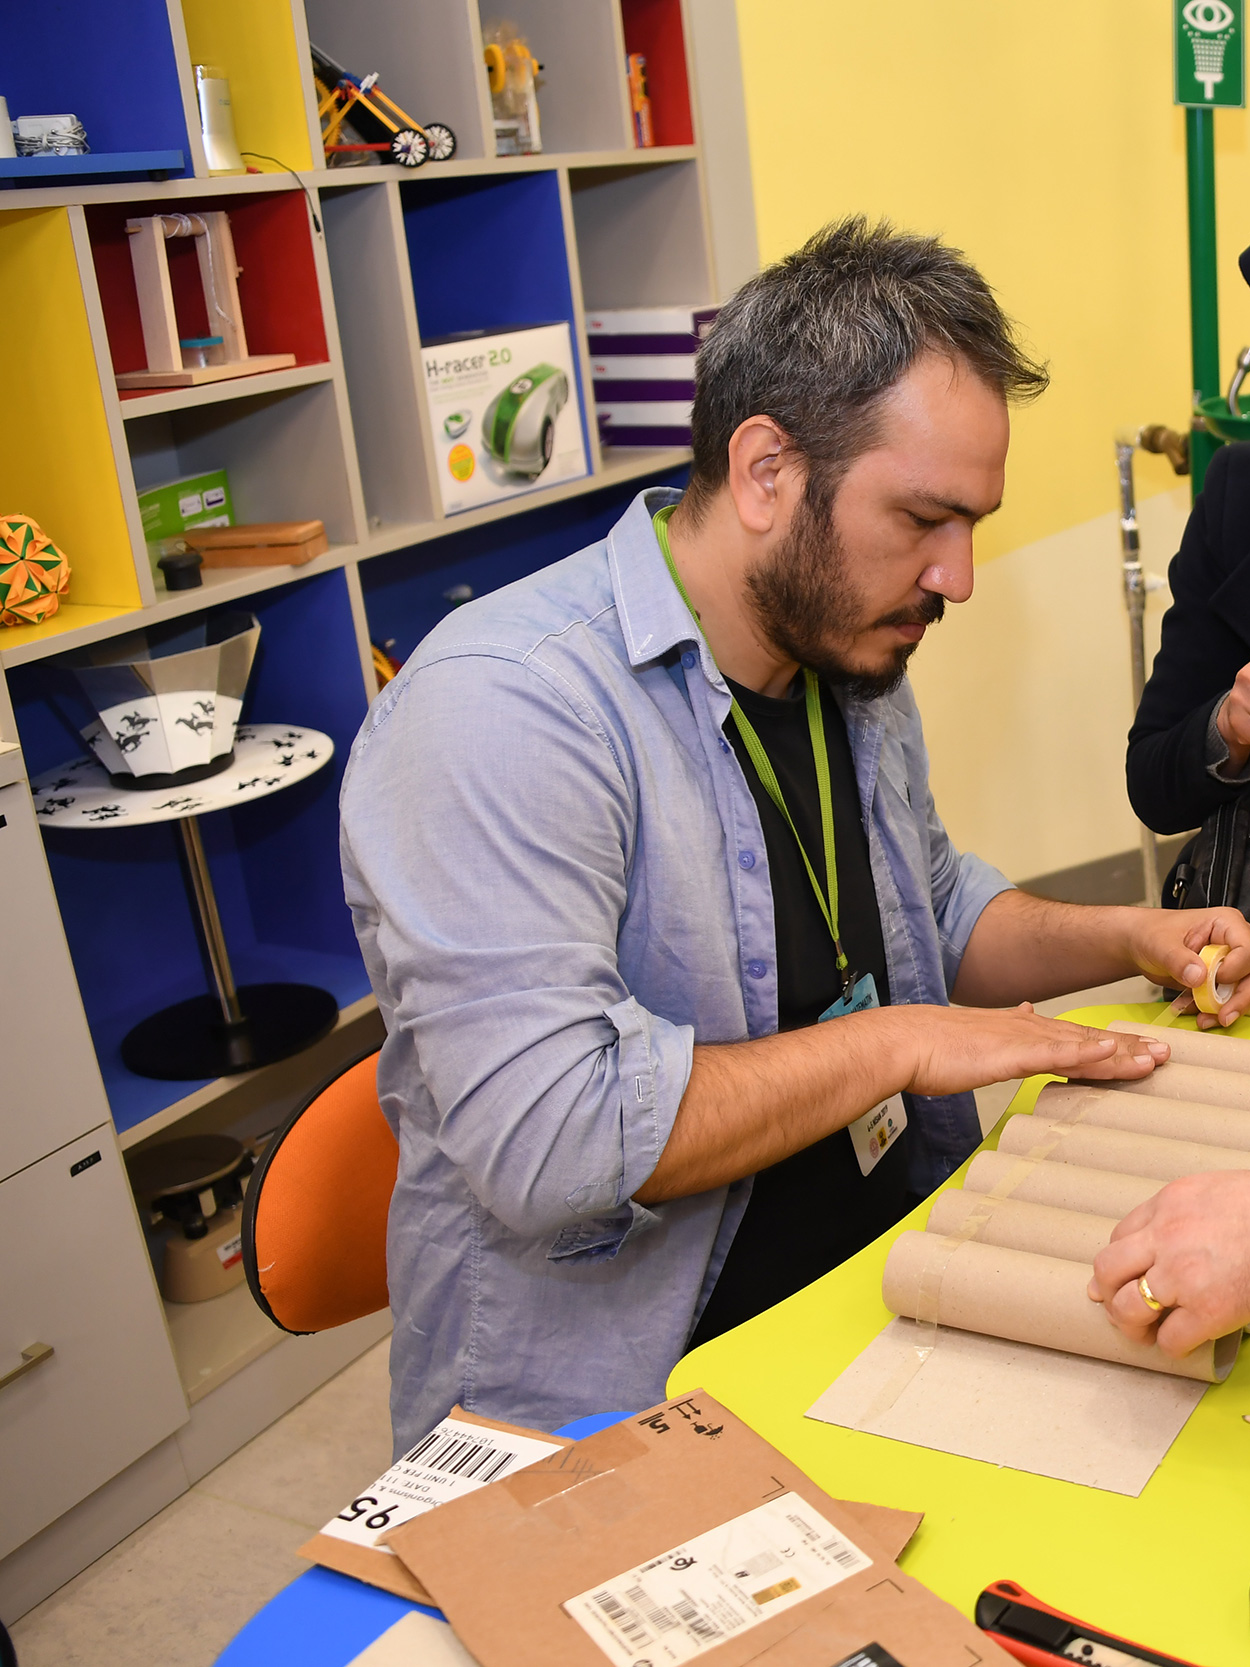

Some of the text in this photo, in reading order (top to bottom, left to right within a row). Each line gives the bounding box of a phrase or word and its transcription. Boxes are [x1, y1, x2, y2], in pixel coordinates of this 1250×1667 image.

[426, 355, 486, 378] H-racer
[402, 1467, 423, 1478] PER
[423, 1473, 447, 1485] UNIT
[336, 1496, 399, 1529] 95
